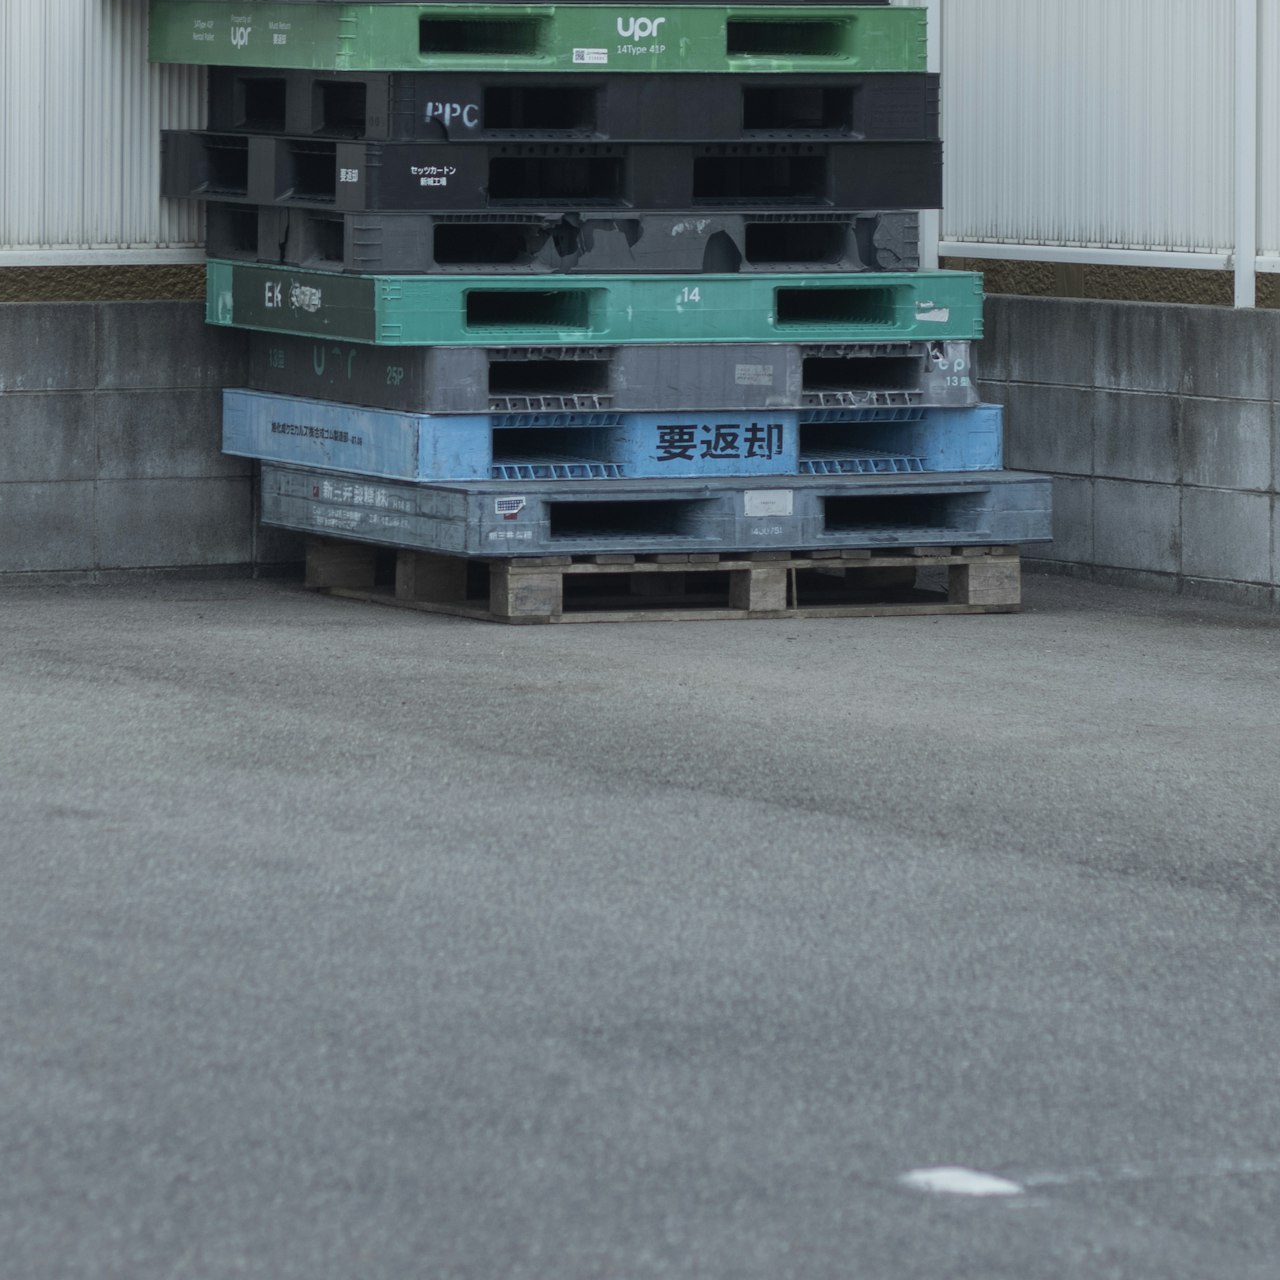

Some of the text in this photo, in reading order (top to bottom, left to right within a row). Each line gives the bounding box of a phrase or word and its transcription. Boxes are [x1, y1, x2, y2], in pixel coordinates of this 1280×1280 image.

[231, 26, 252, 49] upr
[617, 17, 666, 41] upr
[617, 45, 647, 56] 14Type
[649, 45, 665, 54] 41P
[425, 102, 479, 128] PPC
[340, 168, 359, 182] 要返却
[410, 166, 456, 175] セッツカートン
[656, 422, 783, 461] 要返却
